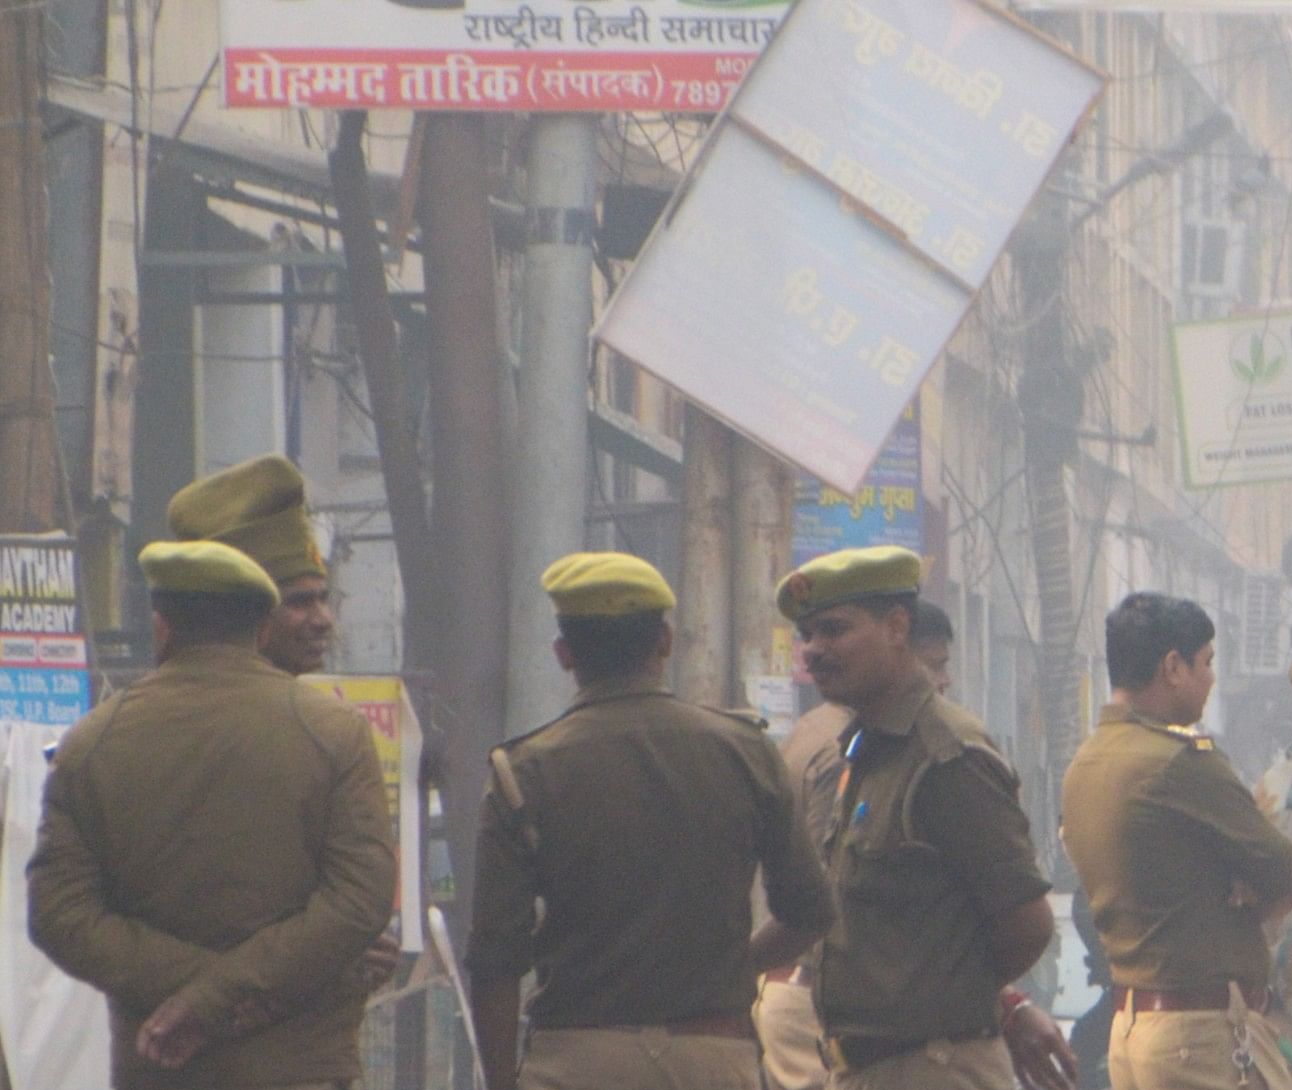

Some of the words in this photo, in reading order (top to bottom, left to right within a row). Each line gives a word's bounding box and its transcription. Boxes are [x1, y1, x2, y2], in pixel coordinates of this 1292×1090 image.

[464, 4, 563, 48] राष्ट्रीय
[574, 4, 650, 46] हिन्दी
[233, 51, 388, 109] मोहम्मद
[396, 54, 522, 104] तारिक
[526, 60, 664, 104] (संपादक)
[1, 601, 76, 634] ACADEMY
